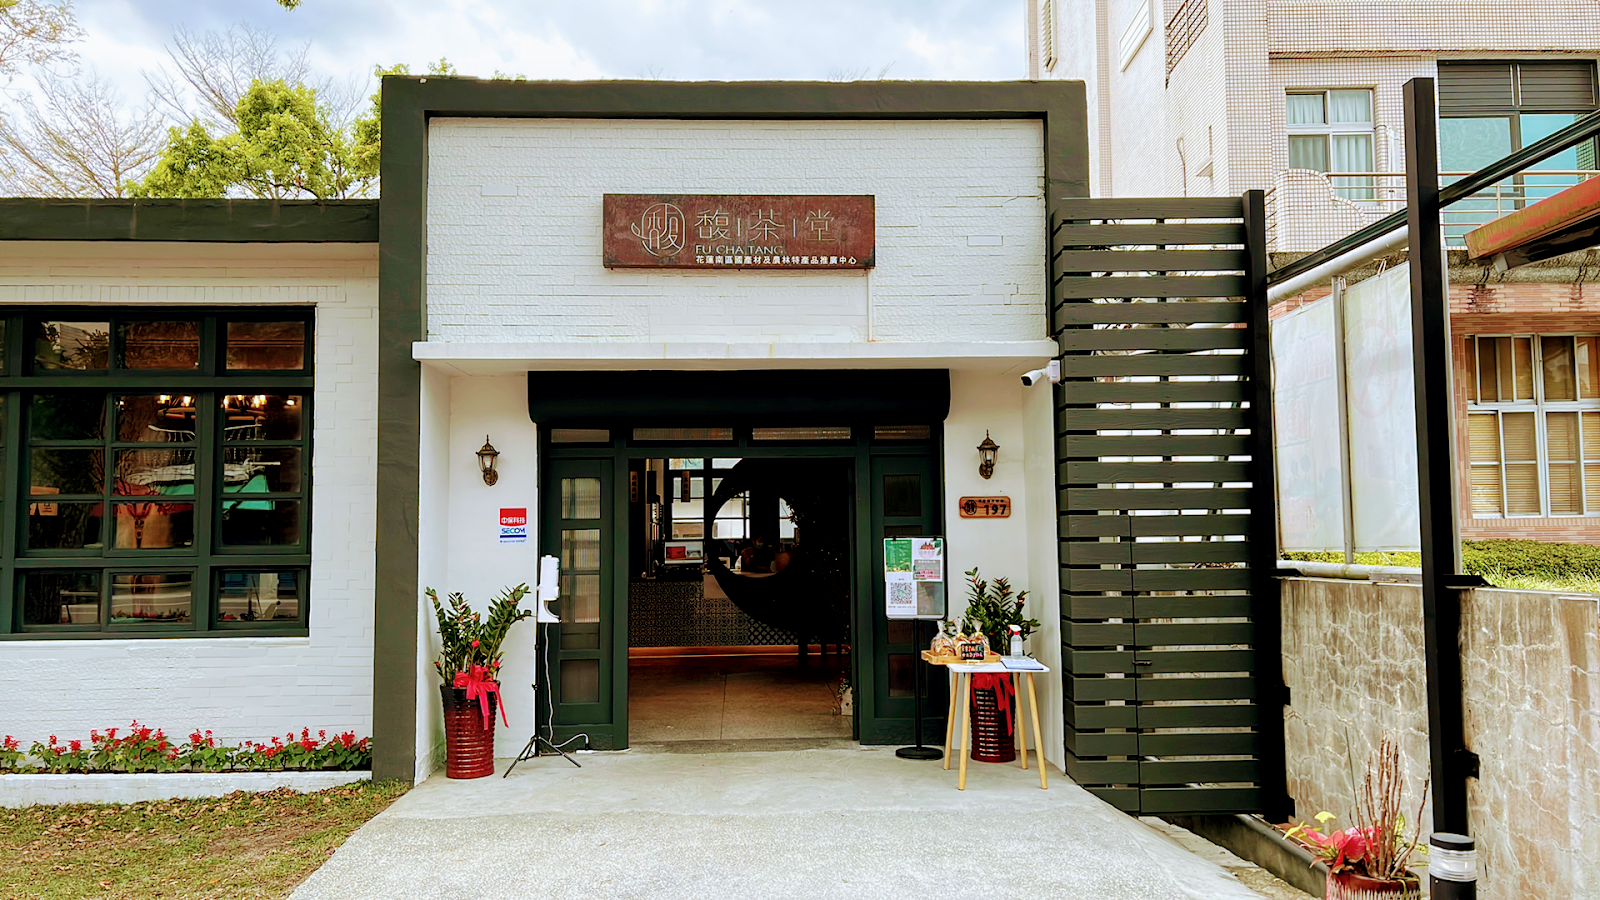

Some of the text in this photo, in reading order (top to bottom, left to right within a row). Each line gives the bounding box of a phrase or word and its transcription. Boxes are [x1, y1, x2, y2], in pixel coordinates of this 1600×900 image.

[695, 245, 784, 254] FU CHA TANG
[984, 504, 1007, 515] 197
[501, 516, 525, 524] 中保科技
